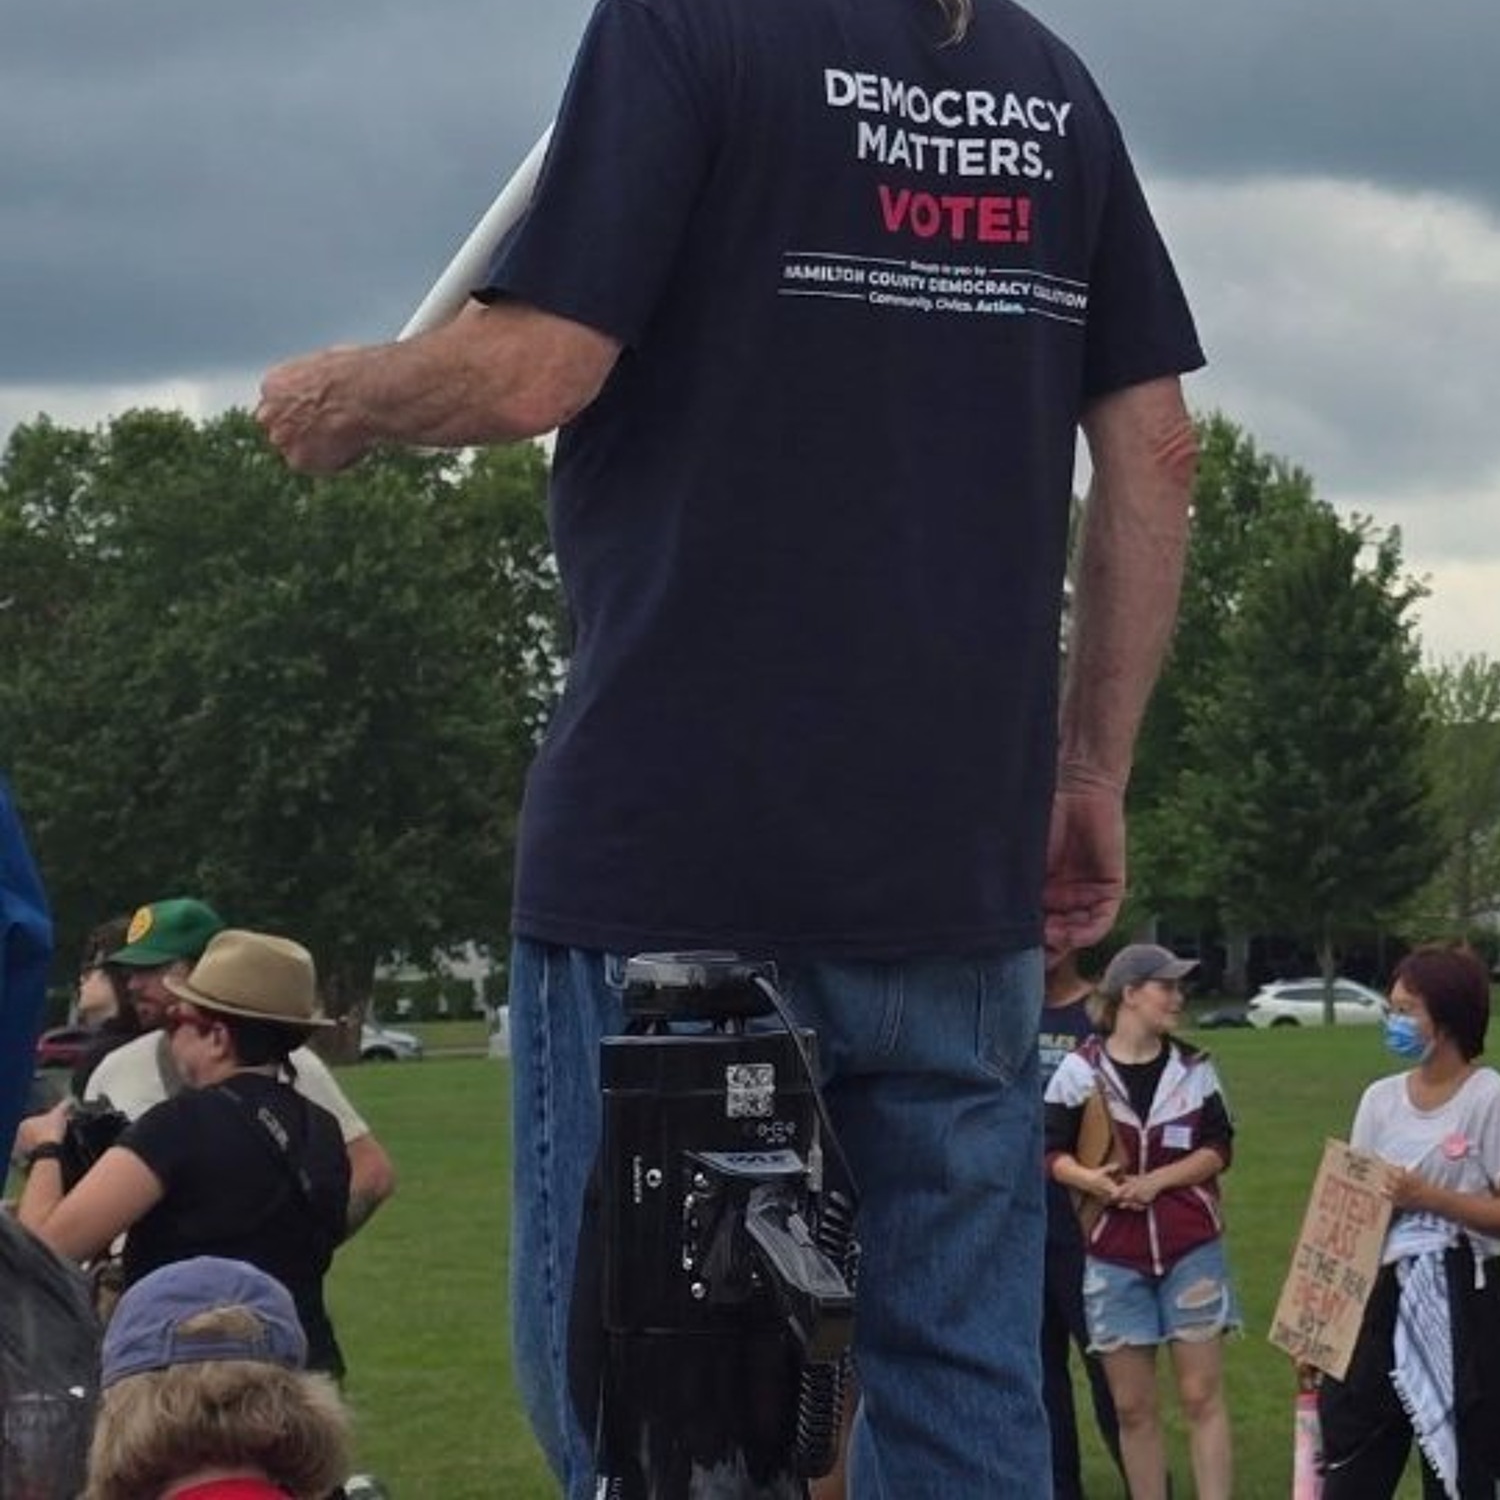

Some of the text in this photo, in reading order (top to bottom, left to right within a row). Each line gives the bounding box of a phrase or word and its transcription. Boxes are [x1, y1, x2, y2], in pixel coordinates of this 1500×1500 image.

[824, 68, 1072, 137] DEMOCRACY
[857, 121, 1053, 181] MATTERS.
[878, 184, 1031, 242] VOTE!
[868, 271, 926, 291] COUNTY
[928, 277, 1031, 297] DEMOCRACY
